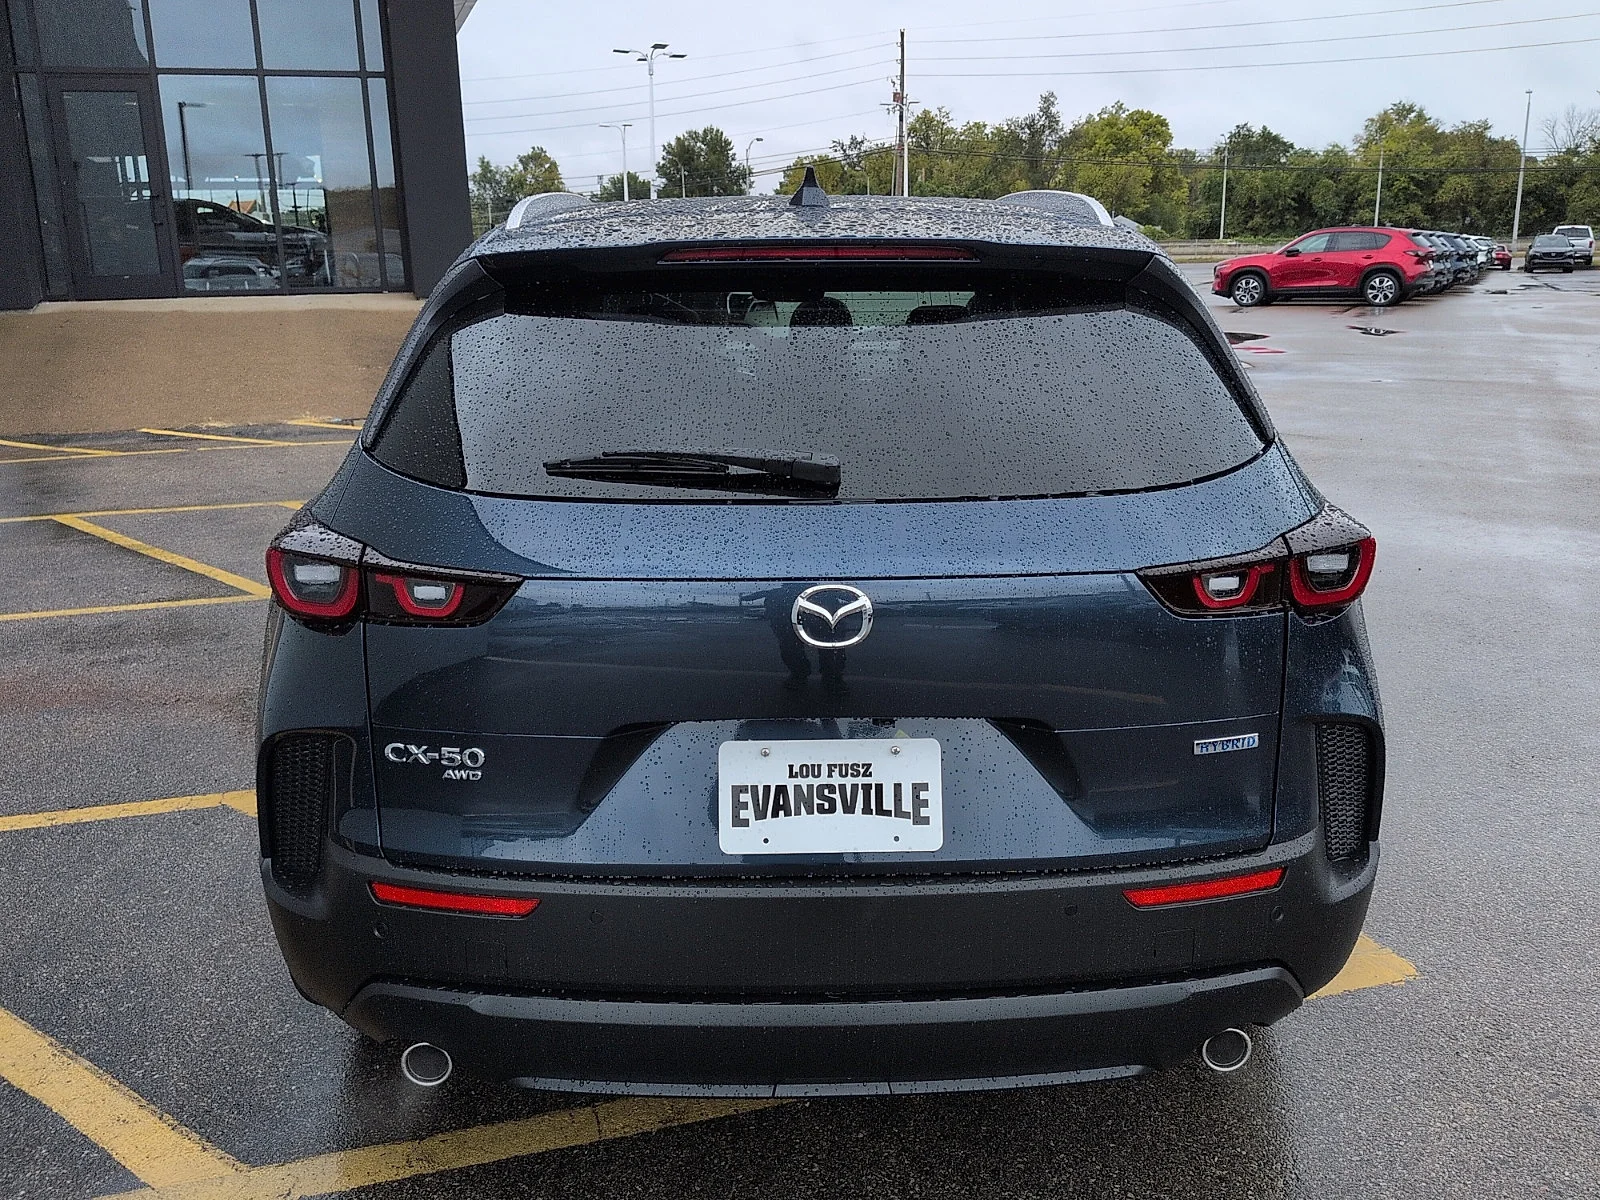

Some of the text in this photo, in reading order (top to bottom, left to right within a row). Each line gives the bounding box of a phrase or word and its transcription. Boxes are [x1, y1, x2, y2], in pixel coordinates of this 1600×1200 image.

[1199, 735, 1256, 753] HYBRID
[384, 742, 486, 768] CX-50
[441, 769, 482, 781] AWD
[788, 763, 873, 779] LOU FUSZ
[731, 782, 931, 828] EVANSVILLE
